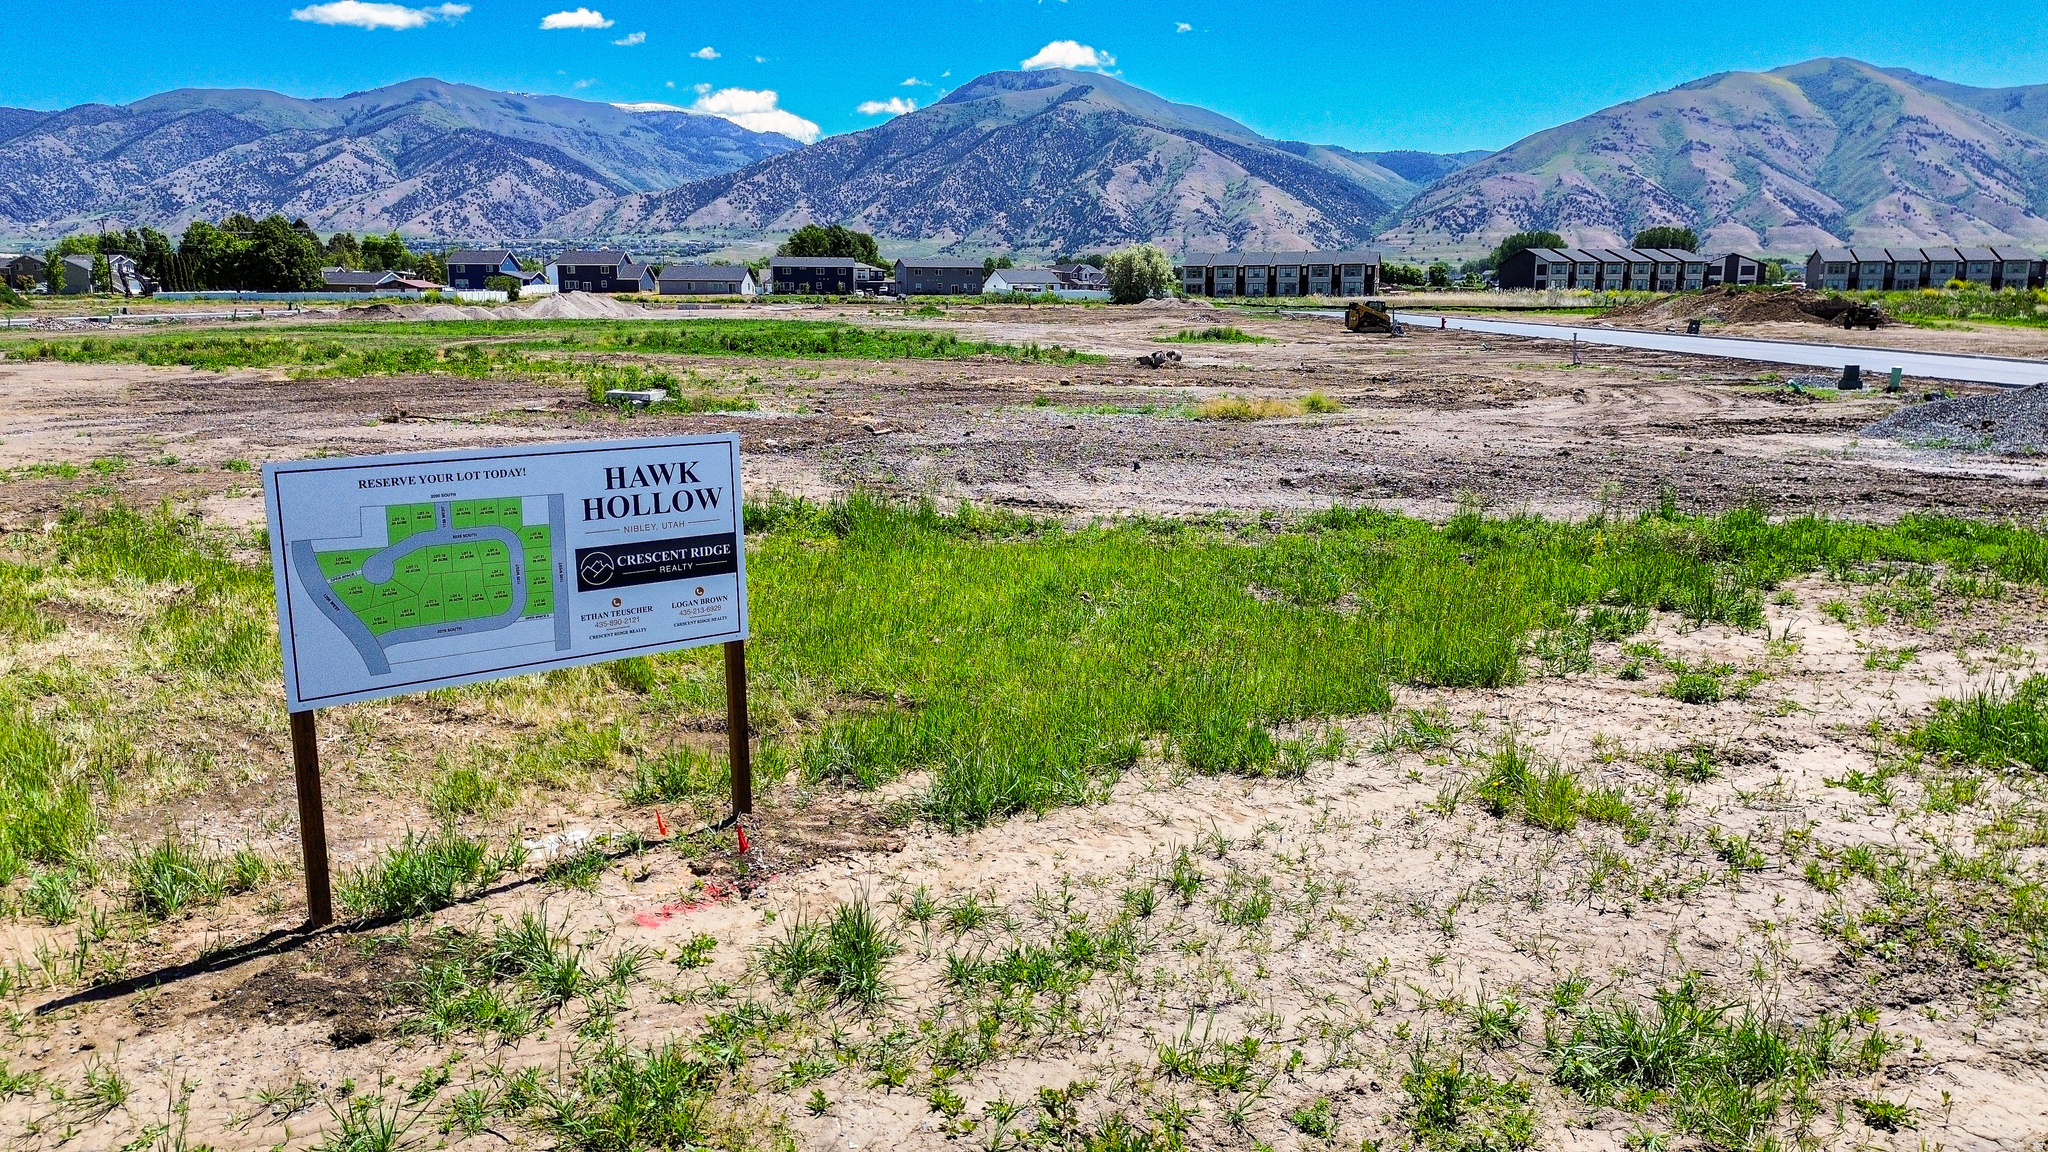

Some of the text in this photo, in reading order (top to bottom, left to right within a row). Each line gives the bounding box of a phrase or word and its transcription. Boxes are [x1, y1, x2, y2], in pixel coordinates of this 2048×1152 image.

[358, 467, 527, 489] RESERVE YOUR LOT TODAY!
[603, 461, 701, 490] HAWK
[581, 486, 723, 521] HOLLOW
[624, 520, 685, 533] NIBLEY, UTAH
[617, 544, 731, 567] CRESCENT RIDGE
[659, 562, 693, 573] REALTY
[671, 595, 728, 609] LOGAN BROWN
[581, 606, 653, 622] ETHAN TEUSCHER
[679, 605, 722, 616] 435-213-6929
[594, 616, 640, 628] 435-890-2121
[589, 632, 614, 640] CRESCENT
